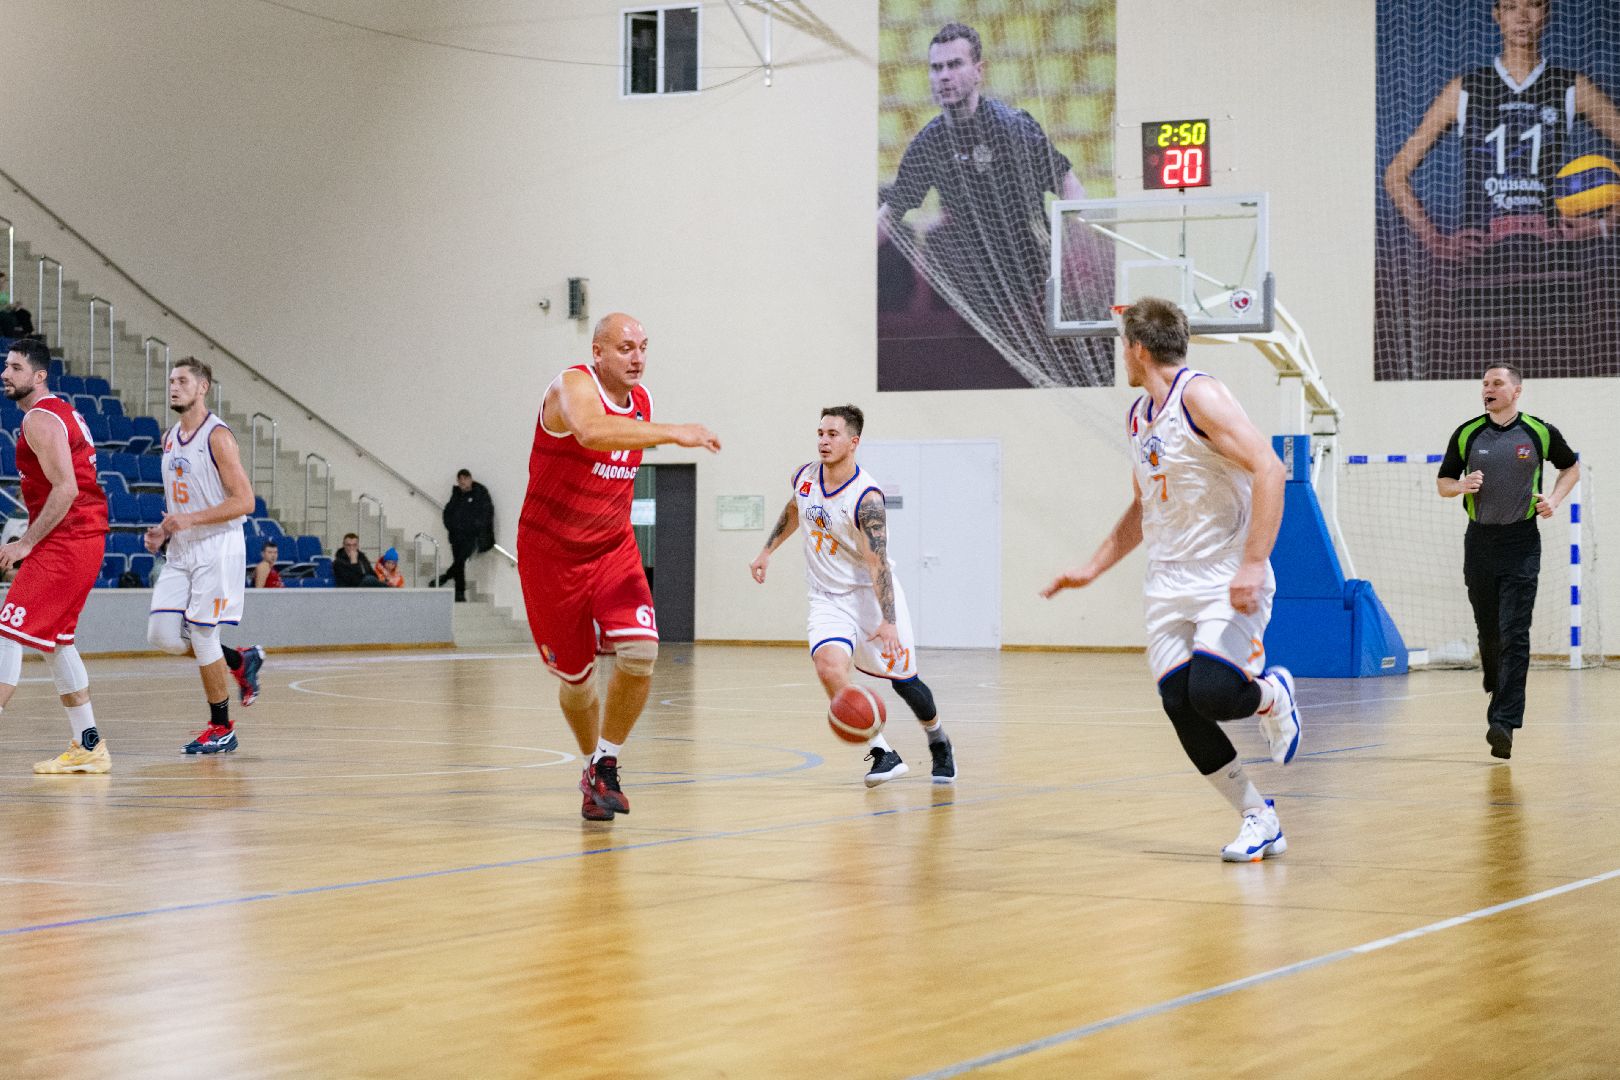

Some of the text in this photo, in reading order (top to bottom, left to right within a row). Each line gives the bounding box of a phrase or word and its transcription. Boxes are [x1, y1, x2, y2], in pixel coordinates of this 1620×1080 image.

[1158, 123, 1206, 147] 2:50
[1485, 123, 1541, 175] 11
[1163, 148, 1202, 185] 20
[592, 462, 639, 480] ПОДОЛЬС
[172, 479, 190, 504] 15
[1153, 474, 1169, 502] 7
[810, 529, 839, 556] 77
[0, 602, 27, 628] 68
